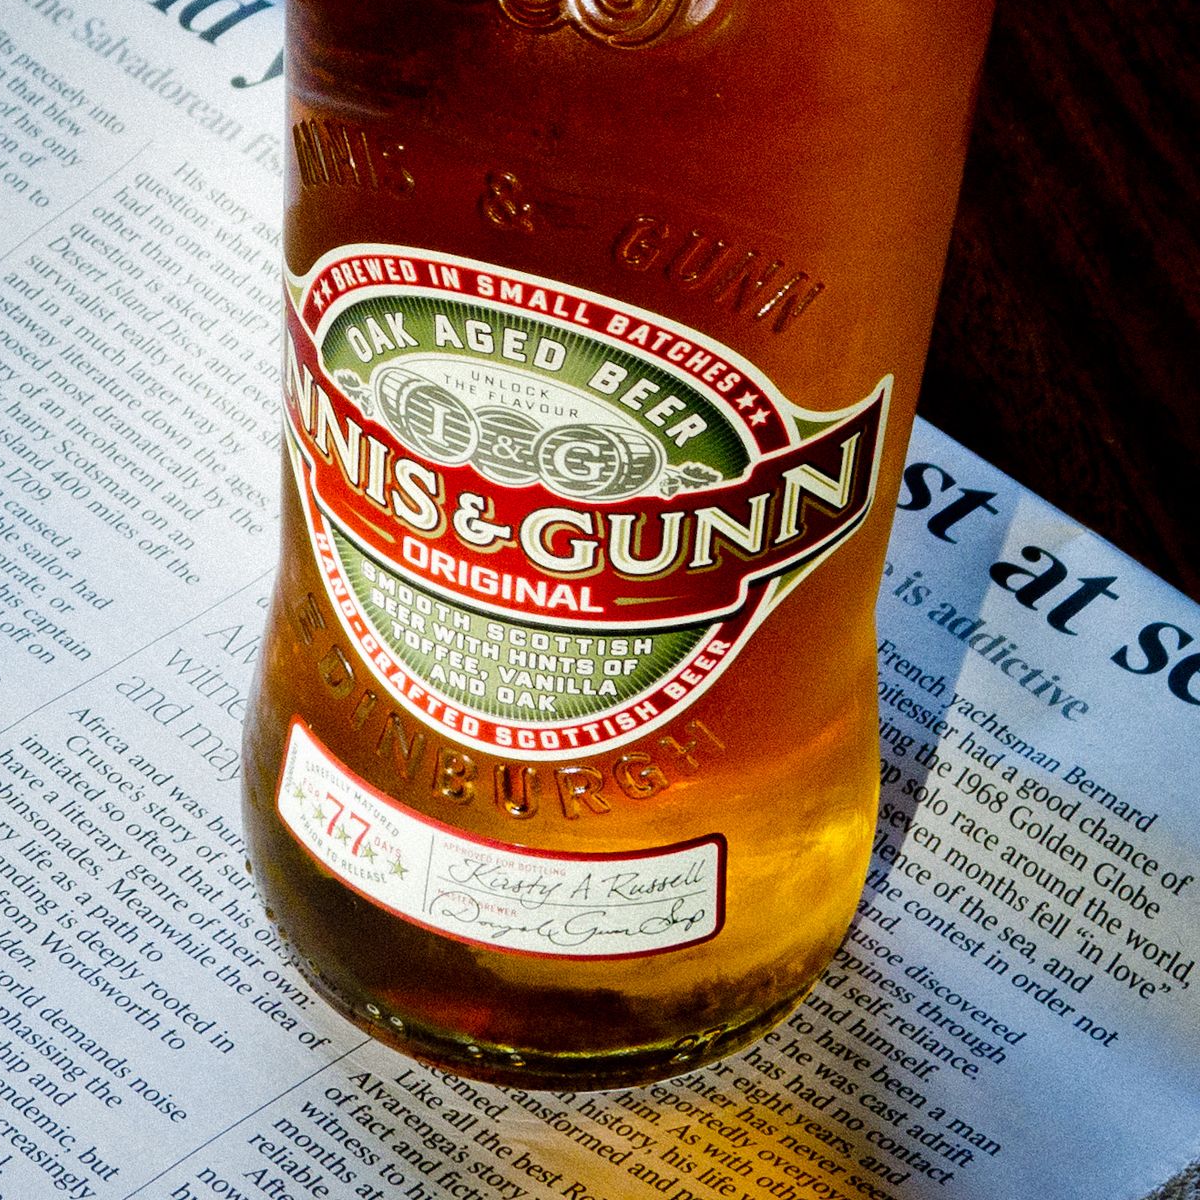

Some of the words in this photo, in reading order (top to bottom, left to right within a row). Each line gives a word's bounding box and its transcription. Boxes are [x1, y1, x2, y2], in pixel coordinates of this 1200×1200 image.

[9, 53, 89, 107] precisely
[87, 105, 125, 133] into
[71, 15, 244, 142] Salvadorean
[331, 256, 417, 294] BREWED
[428, 262, 462, 290] IN
[476, 274, 591, 325] SMALL
[604, 314, 741, 395] BATCHES
[349, 312, 422, 363] OAK
[434, 312, 568, 372] AGED
[587, 356, 709, 449] BEER
[443, 374, 492, 397] THE
[499, 393, 581, 420] FLAVOUR
[470, 370, 552, 399] UNLOCK
[286, 328, 440, 536] NNIS
[521, 431, 864, 578] GUNN
[402, 536, 604, 613] ORIGINAL
[897, 462, 999, 544] st
[989, 545, 1120, 636] at
[313, 531, 482, 739] HAND-CRAFTED
[495, 702, 659, 750] SCOTTISH
[663, 636, 732, 702] BEER
[360, 560, 473, 632] SMOOTH
[486, 623, 653, 656] SCOTTISH
[371, 588, 426, 634] BEER
[431, 627, 499, 661] WITH
[509, 646, 597, 676] HINTS
[603, 657, 639, 678] OF
[893, 570, 932, 608] is
[927, 606, 1090, 722] addictive
[392, 626, 490, 683] TOFFEE,
[500, 664, 619, 696] VANILLA
[431, 665, 486, 698] AND
[497, 686, 558, 713] OAK
[876, 639, 946, 697] French
[940, 692, 1060, 773] yachtsman
[1062, 765, 1158, 832] Bernard
[326, 791, 372, 857] 77
[374, 836, 402, 859] DAYS
[353, 791, 401, 837] MATURED
[915, 741, 953, 778] the
[953, 766, 1008, 813] 1968
[1008, 805, 1088, 871] Golden
[1092, 862, 1160, 919] Globe
[957, 731, 1005, 770] had
[1001, 765, 1018, 783] a
[1015, 777, 1081, 822] good
[1078, 817, 1158, 876] chance
[1160, 871, 1194, 896] of
[341, 859, 388, 884] RELEASE
[570, 873, 592, 900] A
[602, 858, 706, 900] Russell
[881, 803, 942, 855] seven
[943, 847, 1029, 911] months
[1028, 901, 1071, 939] fell
[1076, 927, 1103, 964] “in
[1104, 952, 1171, 999] love”
[904, 779, 949, 817] solo
[950, 810, 999, 851] race
[999, 845, 1085, 907] around
[1082, 897, 1122, 934] the
[1124, 925, 1194, 991] world,
[866, 868, 904, 902] the
[903, 900, 985, 957] contest
[983, 949, 1009, 975] in
[1011, 973, 1075, 1017] order
[1073, 1015, 1118, 1047] not
[932, 881, 965, 903] of
[958, 895, 998, 930] the
[997, 926, 1037, 964] sea,
[1042, 957, 1094, 993] and
[841, 986, 979, 1080] self-reliance.
[845, 1017, 939, 1082] himself.
[903, 965, 1027, 1045] discovered
[915, 1000, 1006, 1064] through
[39, 1008, 131, 1078] demands
[128, 1077, 187, 1121] noise
[84, 1076, 122, 1107] the
